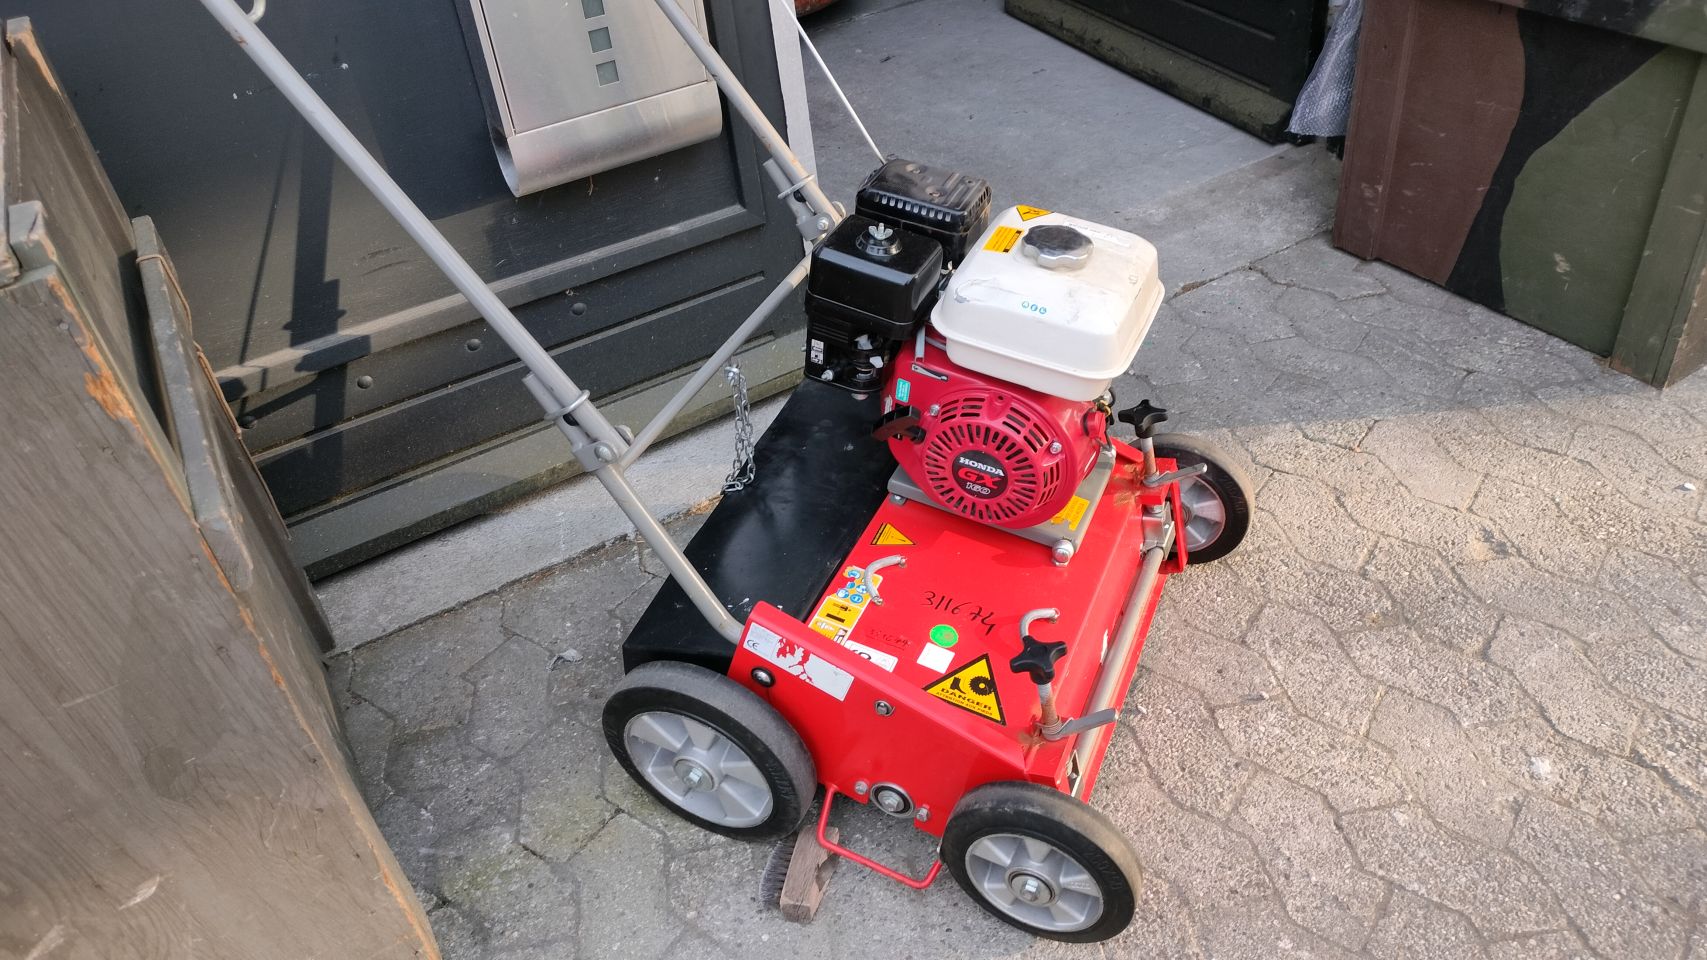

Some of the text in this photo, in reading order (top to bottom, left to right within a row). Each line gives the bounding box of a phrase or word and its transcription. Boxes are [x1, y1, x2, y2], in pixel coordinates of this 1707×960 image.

[959, 456, 1005, 477] HONDA
[957, 467, 1002, 489] GX
[965, 481, 991, 495] 160
[935, 691, 965, 705] ATTENTION
[940, 687, 992, 711] DANGER
